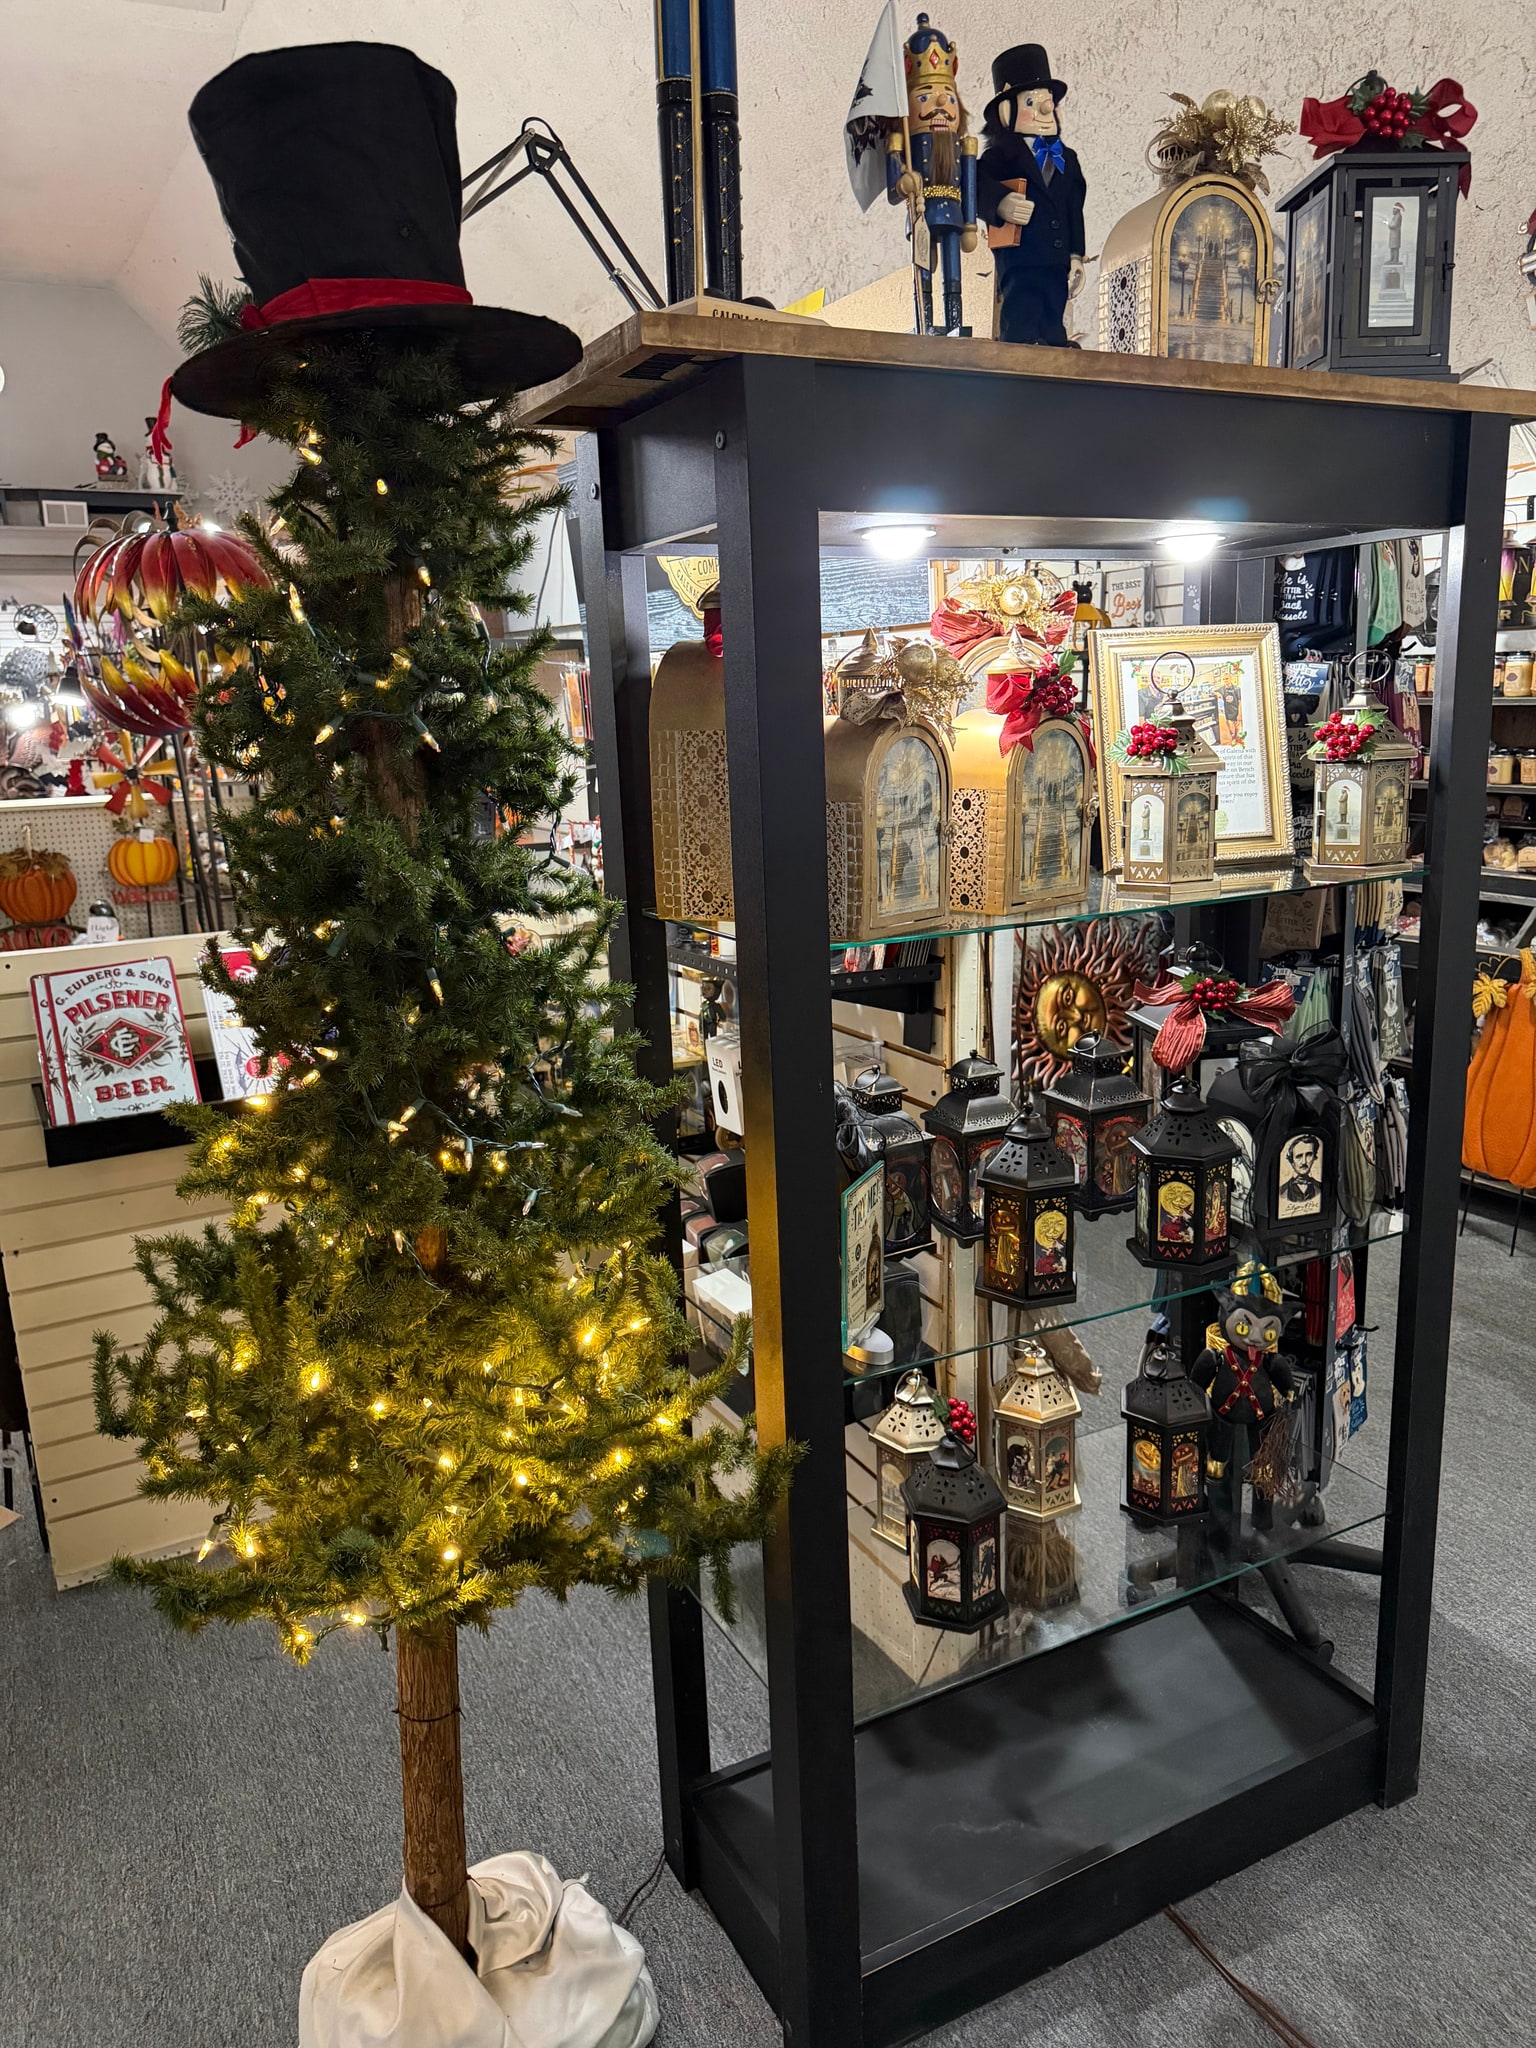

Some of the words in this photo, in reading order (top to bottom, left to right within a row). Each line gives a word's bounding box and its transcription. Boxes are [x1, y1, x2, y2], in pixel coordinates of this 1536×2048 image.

[1112, 582, 1125, 591] THE
[1125, 580, 1141, 589] BEST
[55, 992, 69, 1006] G.
[65, 967, 122, 997] EULBERG
[126, 968, 136, 977] &
[139, 970, 172, 990] SONS
[63, 989, 173, 1027] PILSENER
[712, 1057, 724, 1069] LED
[94, 1075, 176, 1104] BEER.
[852, 1192, 867, 1232] TRY
